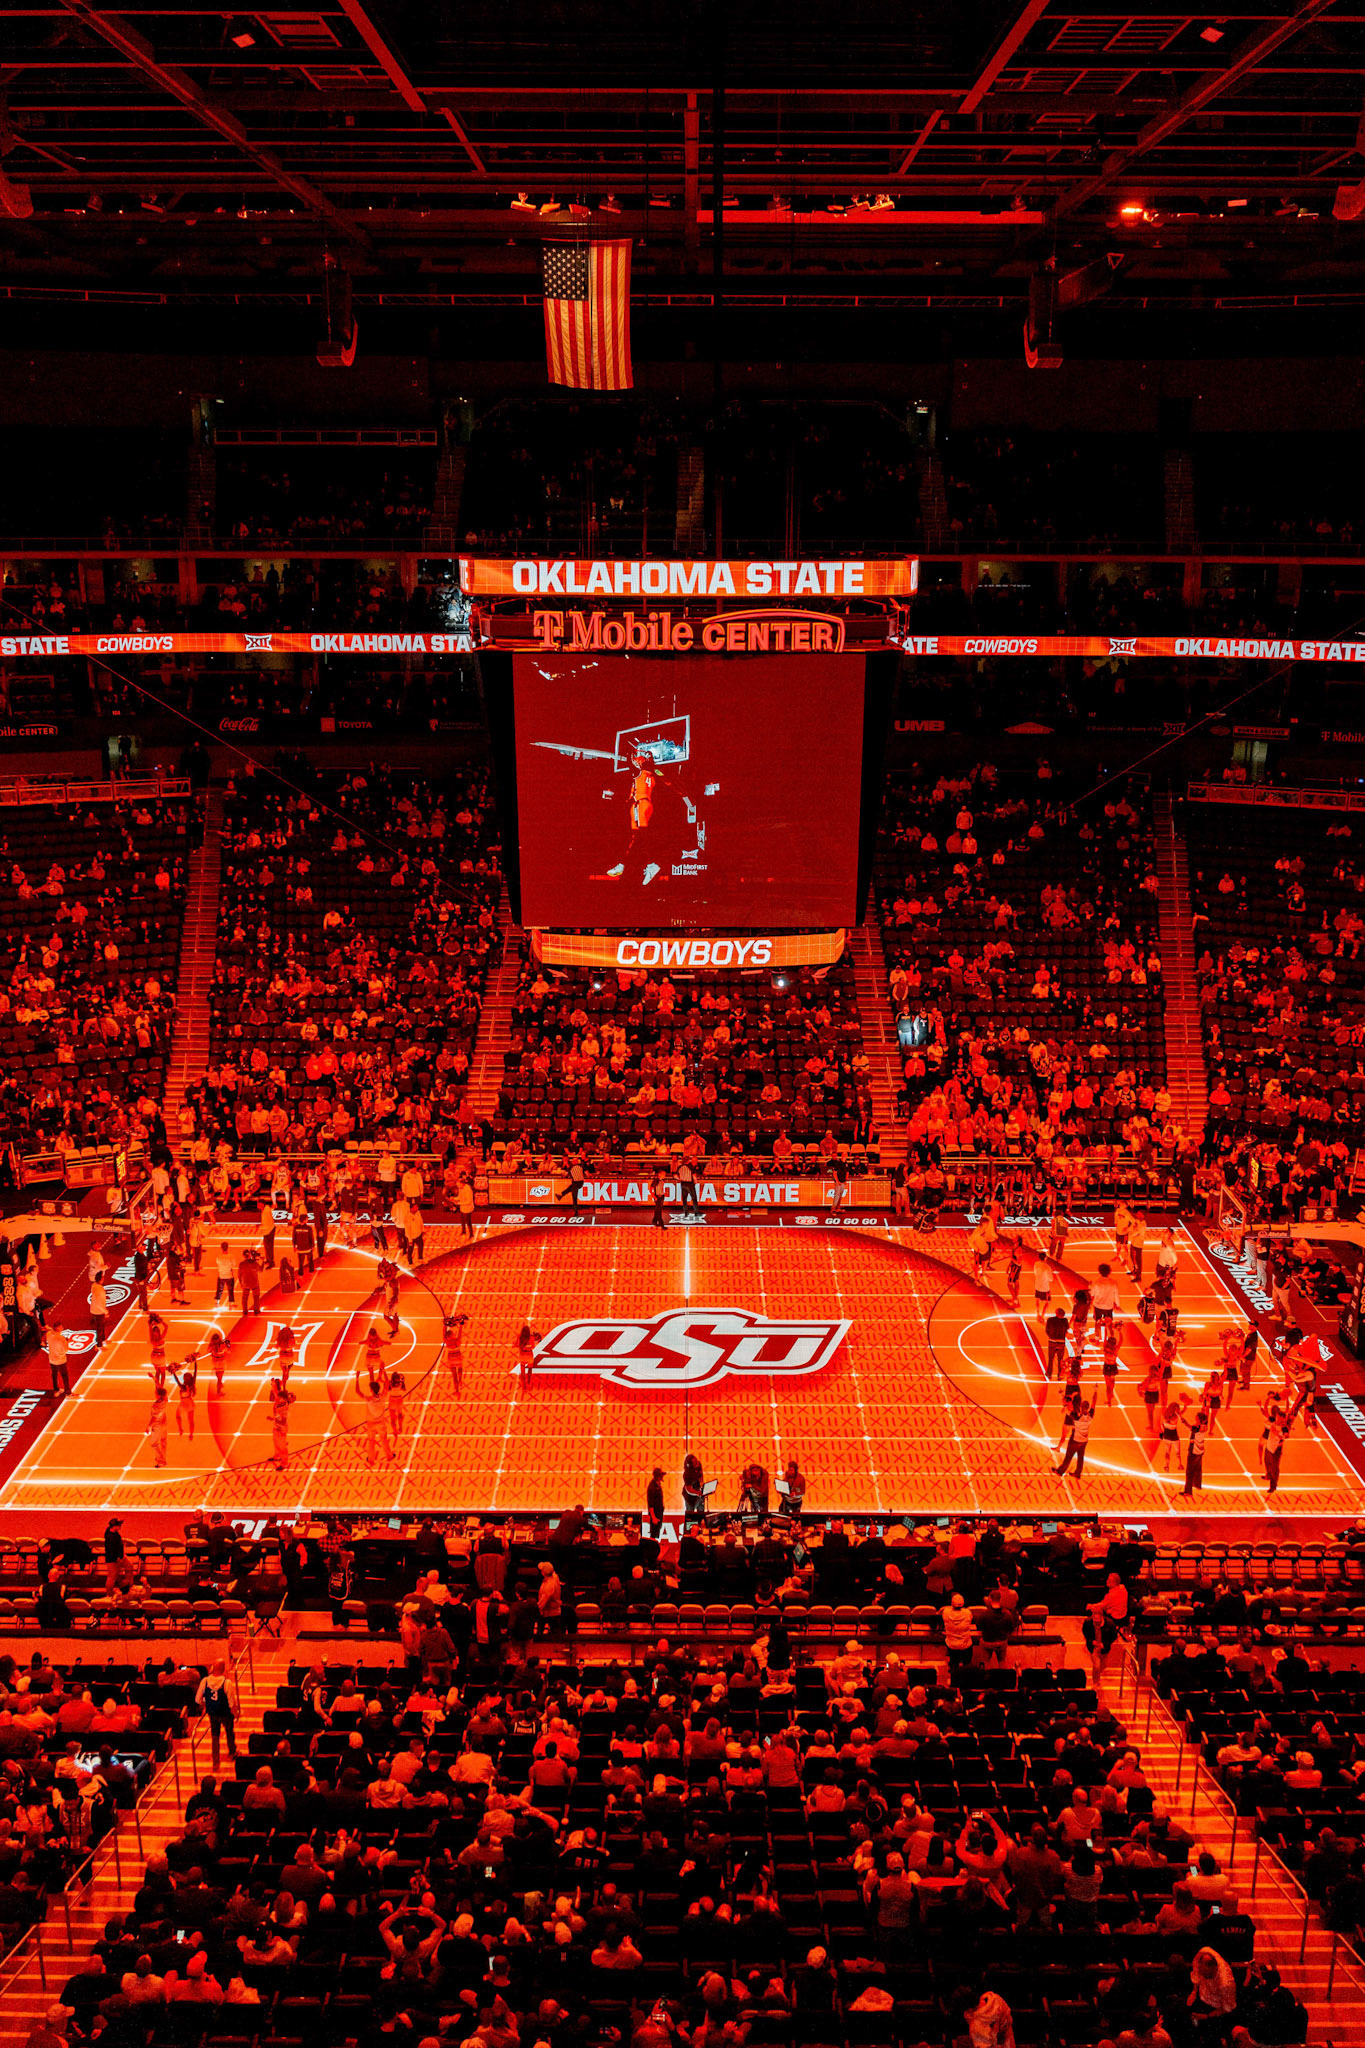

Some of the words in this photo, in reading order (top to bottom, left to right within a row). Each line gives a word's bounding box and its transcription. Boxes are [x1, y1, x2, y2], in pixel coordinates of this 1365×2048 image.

[513, 561, 736, 594] OKLAHOMA
[747, 562, 864, 594] STATE
[568, 611, 693, 650] Mobile
[702, 621, 833, 651] CENTER
[1, 637, 69, 655] STATE
[97, 636, 173, 651] COWBOYS
[311, 635, 426, 651] OKLAHOMA
[431, 635, 471, 652] STA
[902, 637, 938, 653] ATE
[964, 639, 1037, 653] COWBOYS
[1175, 639, 1294, 658] OKLAHOMA
[1301, 642, 1365, 660] STATE
[19, 727, 55, 736] CENTER
[894, 720, 945, 732] UMB
[617, 940, 772, 965] COWBOYS
[723, 1183, 799, 1202] STATE
[2, 1276, 14, 1286] GO
[4, 1286, 14, 1296] GO
[511, 1307, 854, 1389] OSU
[7, 1389, 46, 1417] CITY
